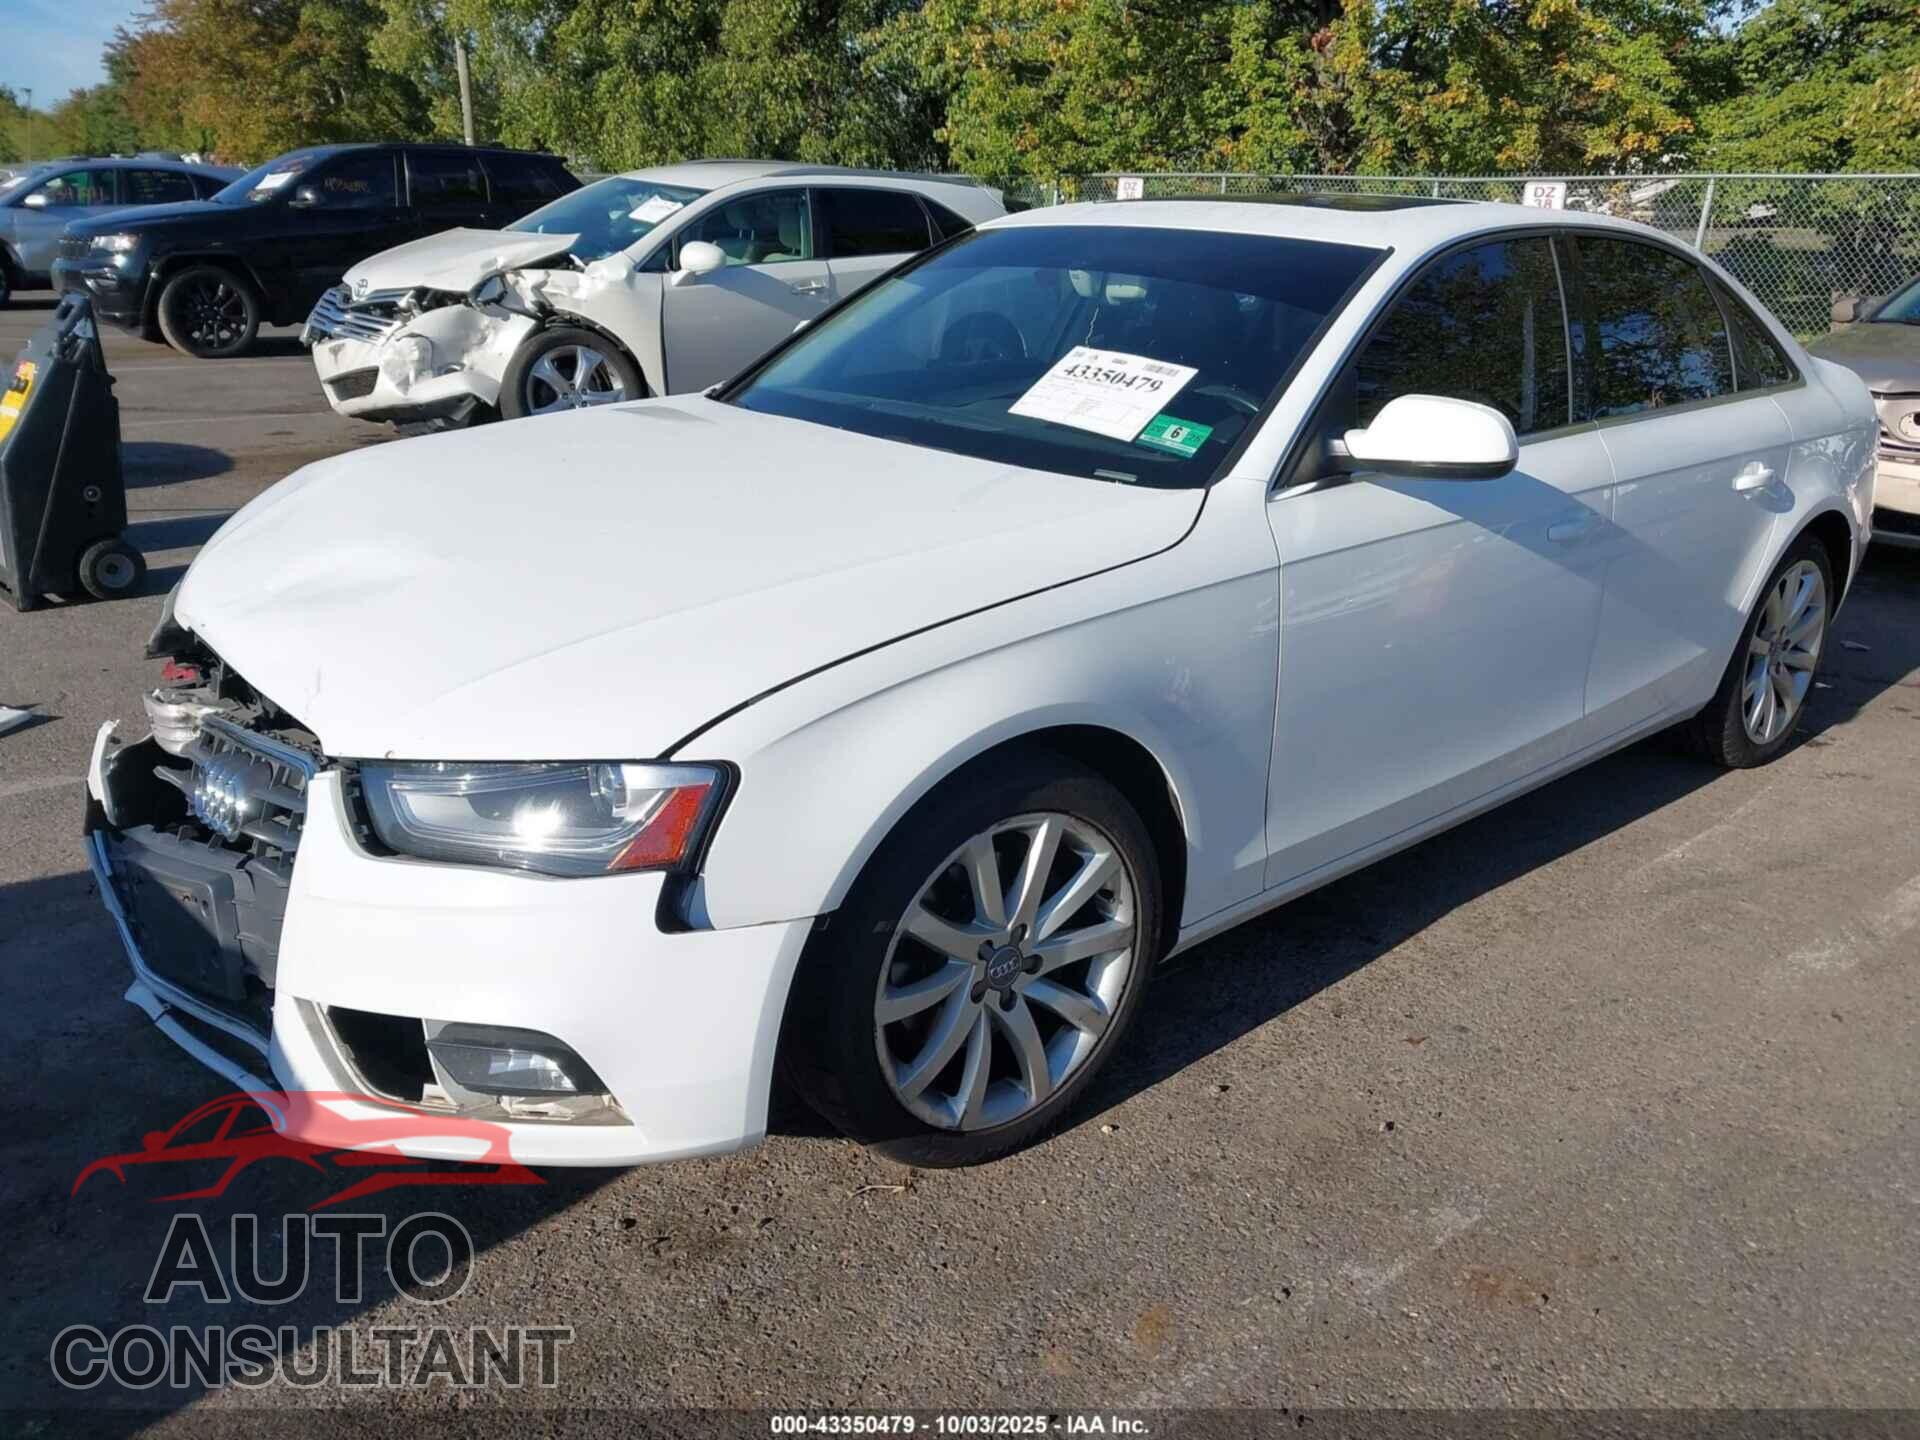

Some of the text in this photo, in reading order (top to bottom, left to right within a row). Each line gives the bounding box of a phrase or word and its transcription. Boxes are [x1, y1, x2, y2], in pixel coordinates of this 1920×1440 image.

[1123, 181, 1138, 191] DZ
[1534, 186, 1556, 198] DZ
[1063, 363, 1164, 393] 43350479
[1170, 426, 1183, 439] 6
